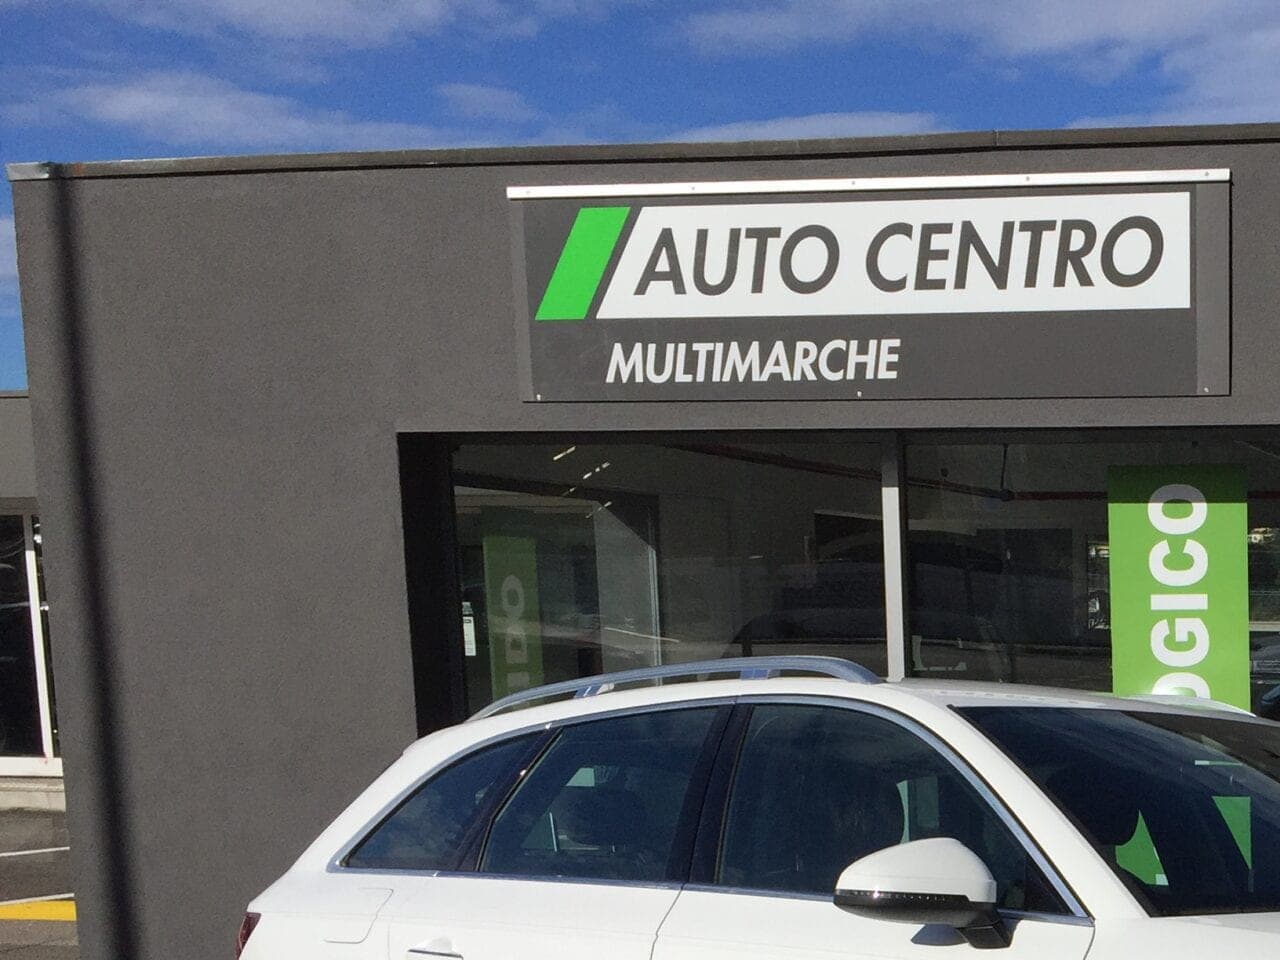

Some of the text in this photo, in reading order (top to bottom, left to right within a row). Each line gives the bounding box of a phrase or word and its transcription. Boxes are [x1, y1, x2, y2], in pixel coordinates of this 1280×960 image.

[634, 215, 1164, 296] AUTO CENTRO
[605, 338, 901, 384] MULTIMARCHE
